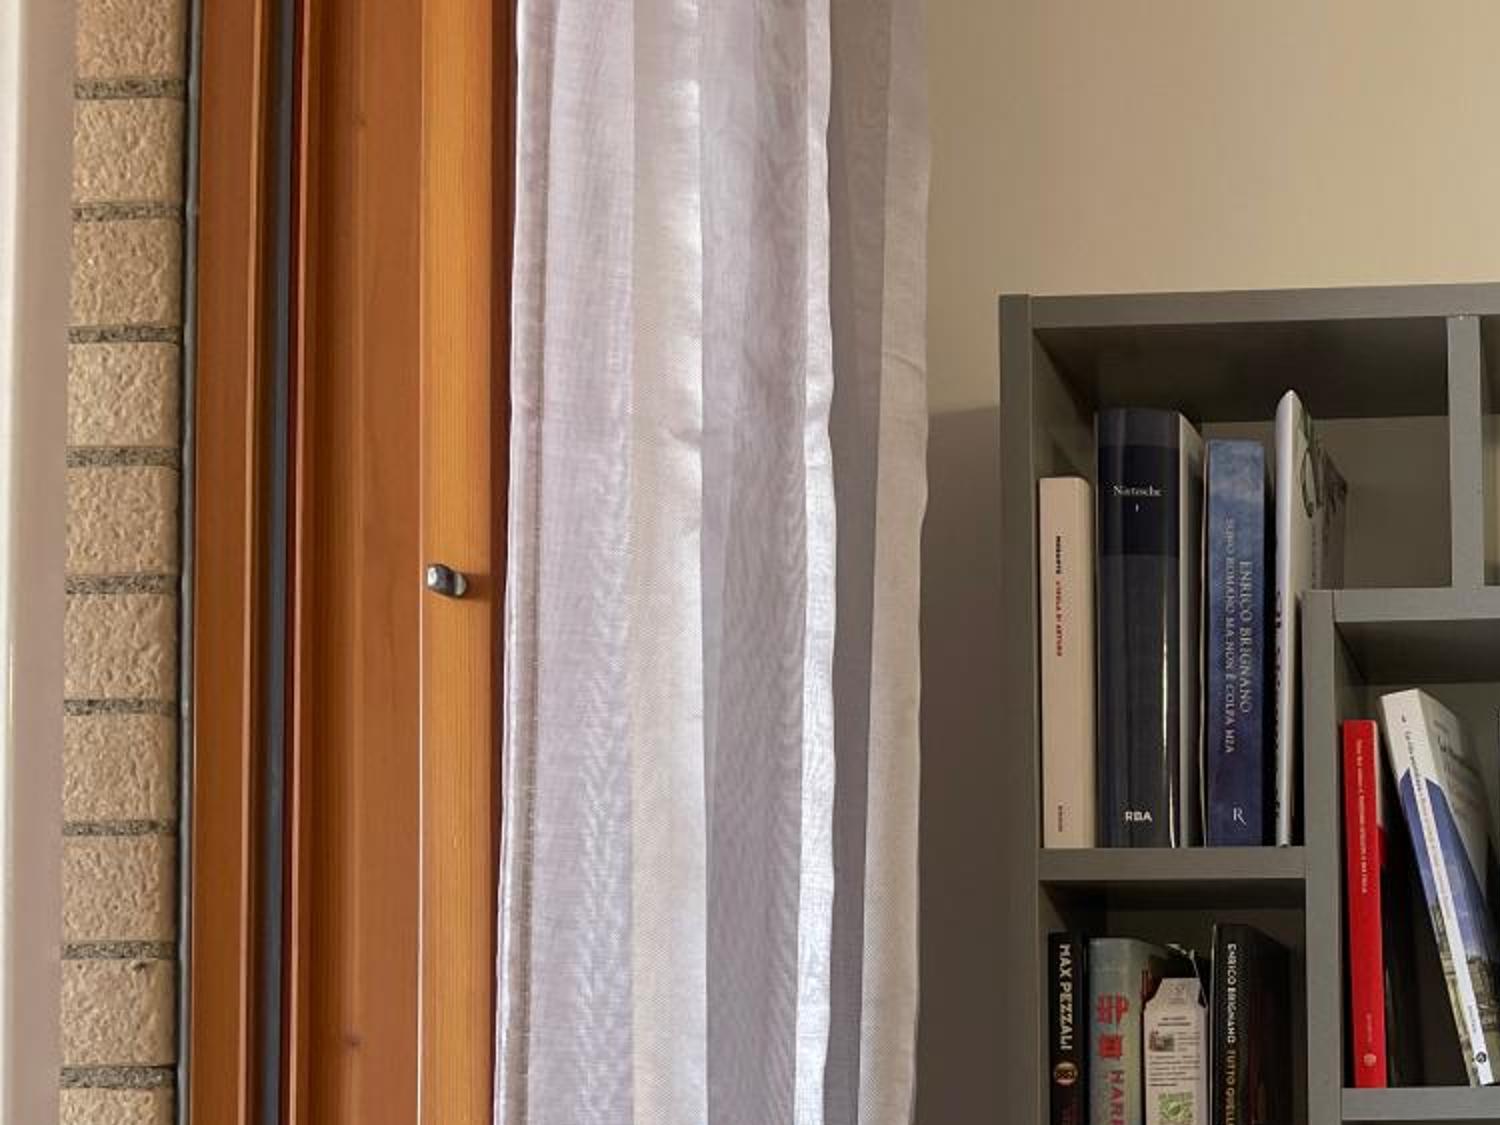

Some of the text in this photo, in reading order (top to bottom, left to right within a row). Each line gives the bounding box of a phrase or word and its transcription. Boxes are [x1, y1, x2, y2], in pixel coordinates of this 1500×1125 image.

[1224, 557, 1237, 614] ROMANO
[1239, 561, 1254, 713] ENRICO BRIGNANO
[1225, 683, 1238, 726] COLPA
[1225, 729, 1237, 754] MIA
[1124, 811, 1153, 822] RBA
[1226, 943, 1238, 985] ENRICO
[1059, 943, 1074, 1050] MAX PEZZALI
[1226, 986, 1238, 1043] BRIGNANO
[1226, 1049, 1237, 1084] TUTTO
